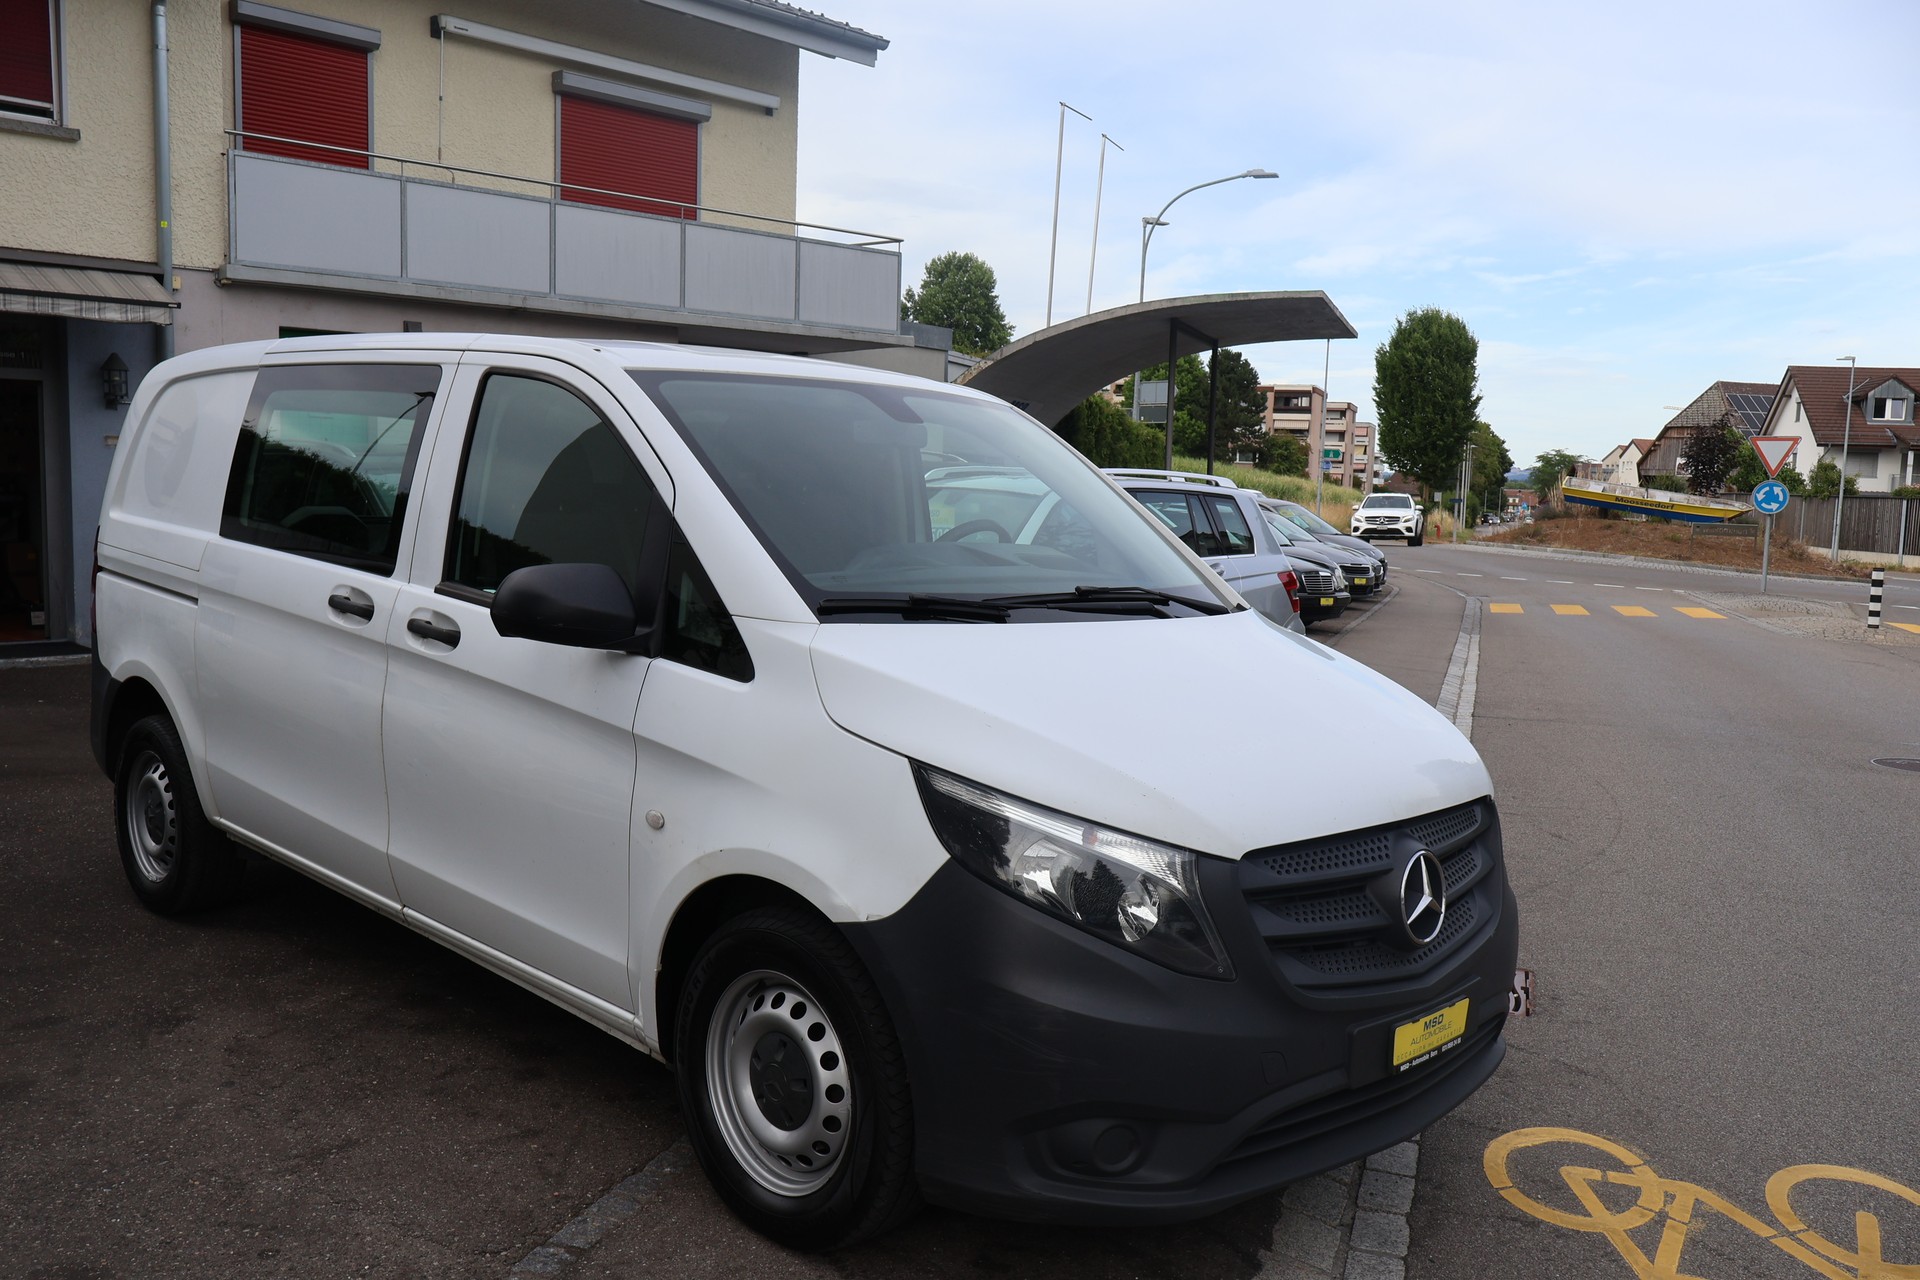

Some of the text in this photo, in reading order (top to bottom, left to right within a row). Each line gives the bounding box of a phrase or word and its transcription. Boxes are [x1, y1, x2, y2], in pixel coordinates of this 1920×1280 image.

[1615, 496, 1675, 510] Moosseedorf
[1424, 1014, 1444, 1031] MSD
[1411, 1022, 1452, 1045] AUTOMOBILE
